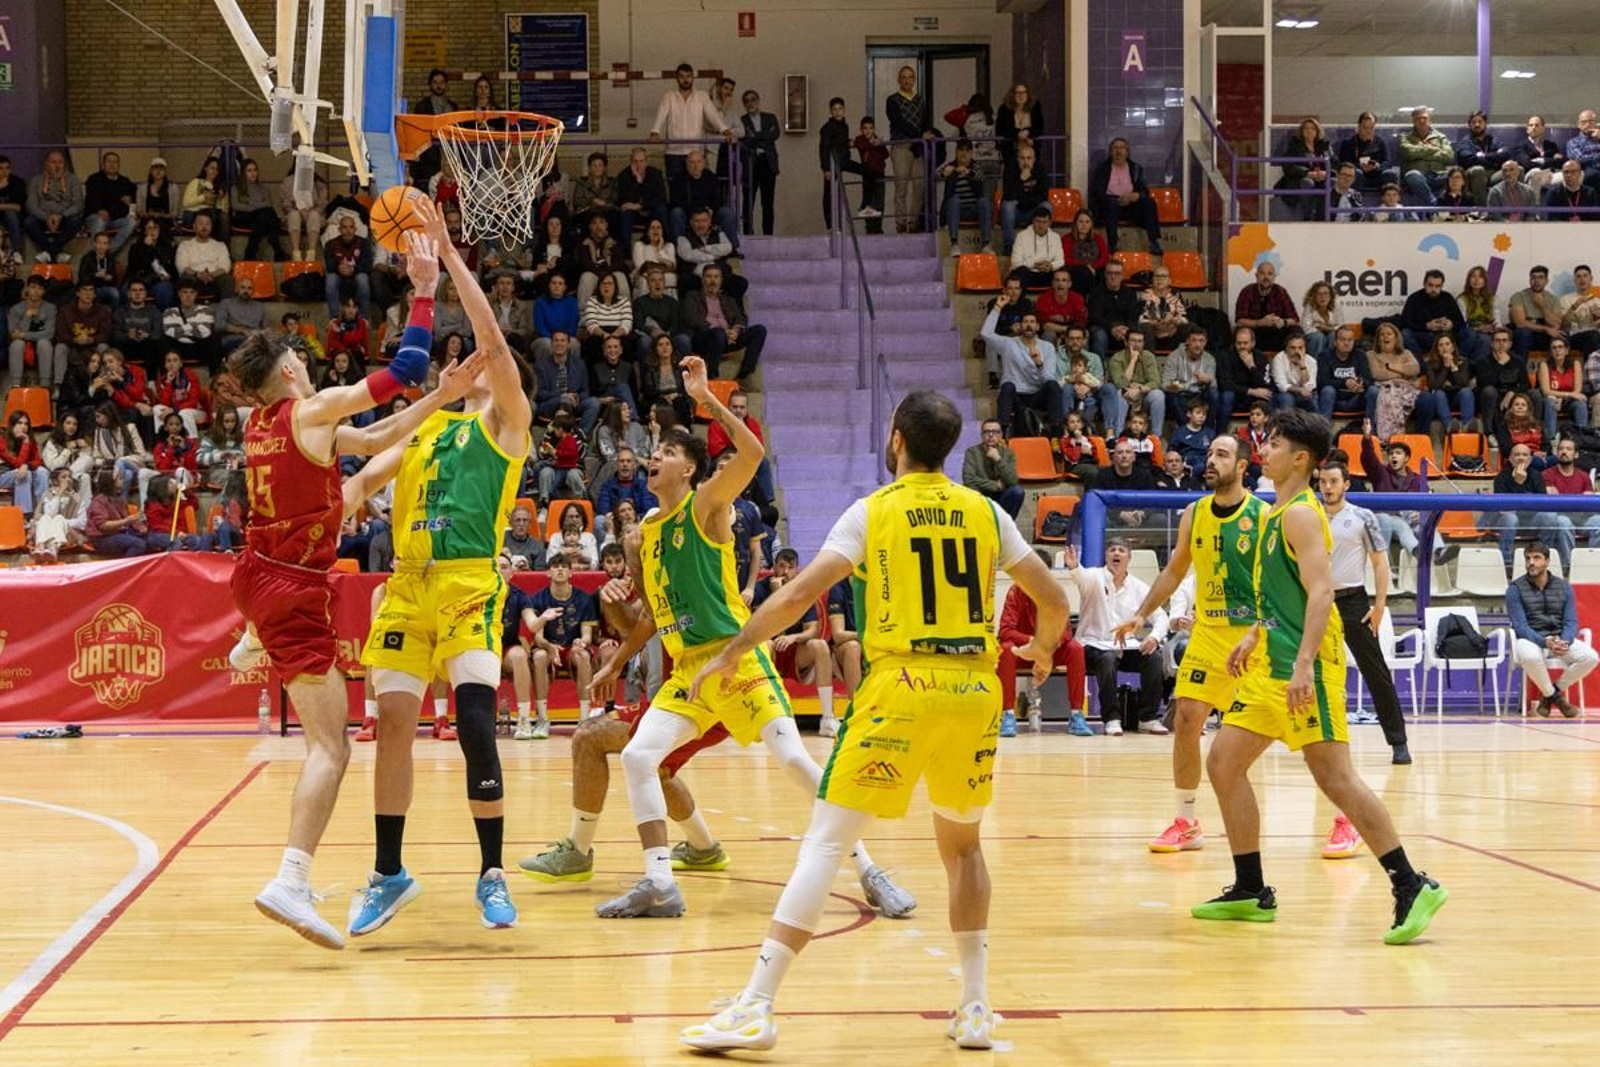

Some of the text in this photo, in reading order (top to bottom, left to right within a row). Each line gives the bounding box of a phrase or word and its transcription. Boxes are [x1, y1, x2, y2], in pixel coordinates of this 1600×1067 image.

[1123, 44, 1144, 71] A
[906, 507, 967, 529] DAVID M.
[910, 536, 985, 625] 14
